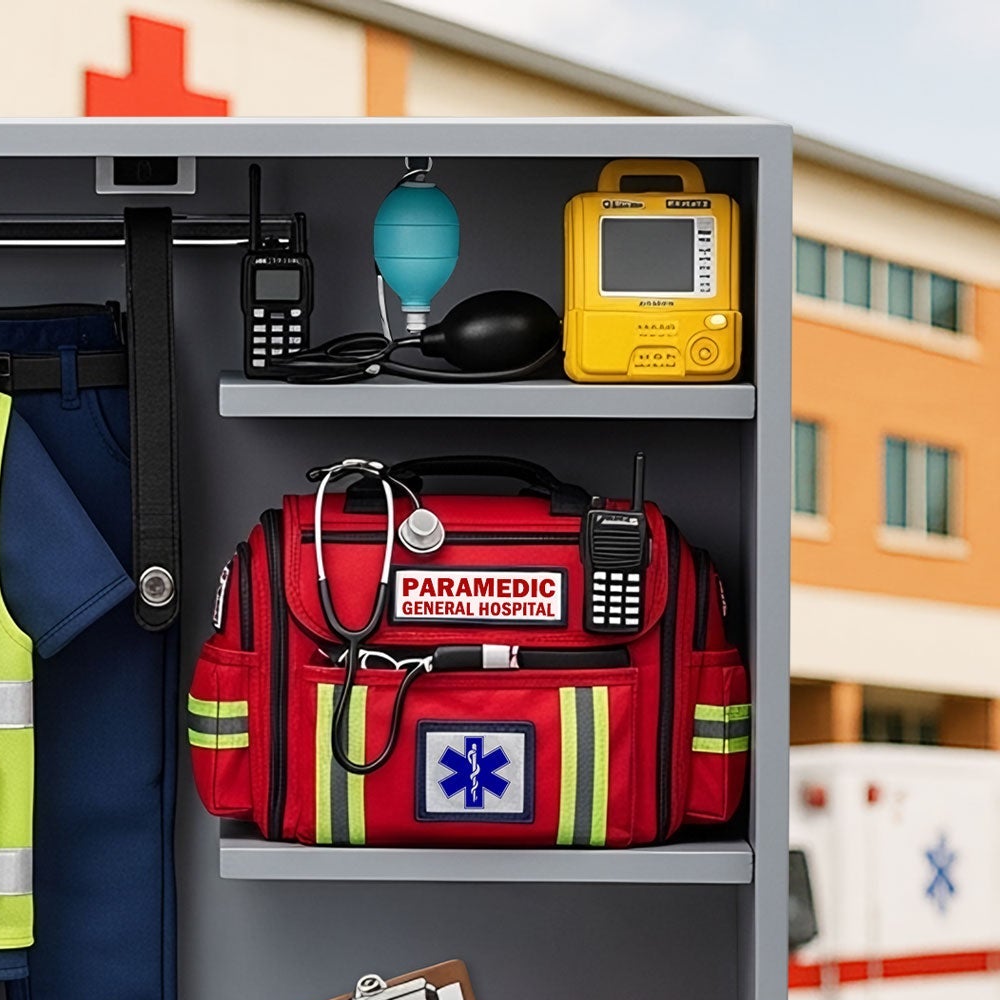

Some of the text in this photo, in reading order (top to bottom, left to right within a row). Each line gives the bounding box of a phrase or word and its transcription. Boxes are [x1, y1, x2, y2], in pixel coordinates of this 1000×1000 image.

[402, 577, 556, 598] PARAMEDIC
[402, 601, 555, 617] GENERAL HOSPITAL
